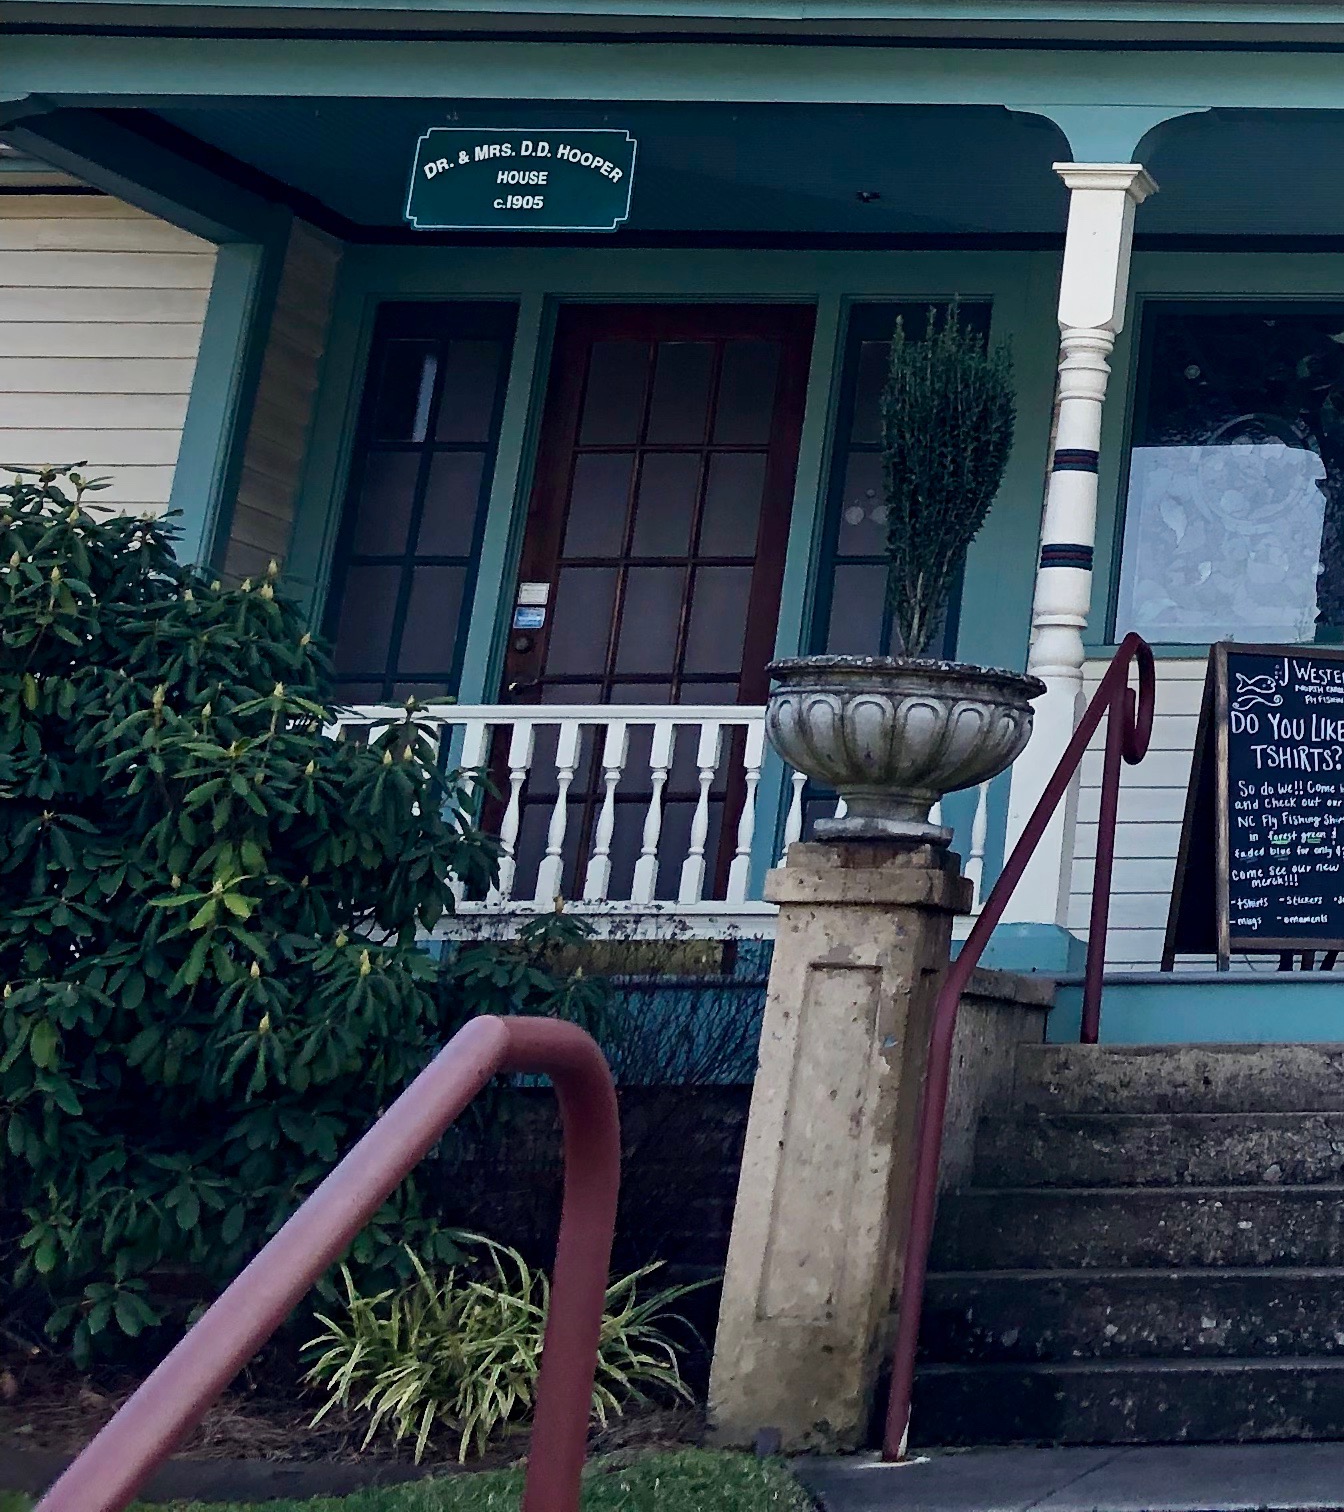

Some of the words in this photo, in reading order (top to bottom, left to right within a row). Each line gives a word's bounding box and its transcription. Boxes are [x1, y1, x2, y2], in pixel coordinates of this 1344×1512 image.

[423, 158, 454, 179] DR.
[458, 150, 469, 165] &
[474, 143, 516, 162] MRS.
[520, 140, 551, 157] D.D.
[556, 144, 623, 183] HOOPER
[496, 170, 548, 185] HOUSE
[493, 195, 544, 209] c.1905
[1231, 710, 1259, 734] DO
[1267, 713, 1304, 741] YOU
[1250, 745, 1343, 772] TSHIRTS?
[1238, 780, 1255, 797] So
[1260, 782, 1274, 796] do
[1306, 780, 1335, 793] Come
[1234, 799, 1259, 810] and
[1301, 797, 1322, 807] out
[1237, 815, 1255, 827] NC
[1261, 814, 1278, 830] Fly
[1281, 812, 1321, 827] Fishing
[1267, 830, 1298, 841] forest
[1301, 831, 1326, 843] green
[1235, 847, 1265, 858] faded
[1270, 847, 1291, 856] blue
[1296, 845, 1309, 855] for
[1314, 845, 1332, 858] only
[1291, 864, 1312, 873] our
[1316, 863, 1340, 872] new
